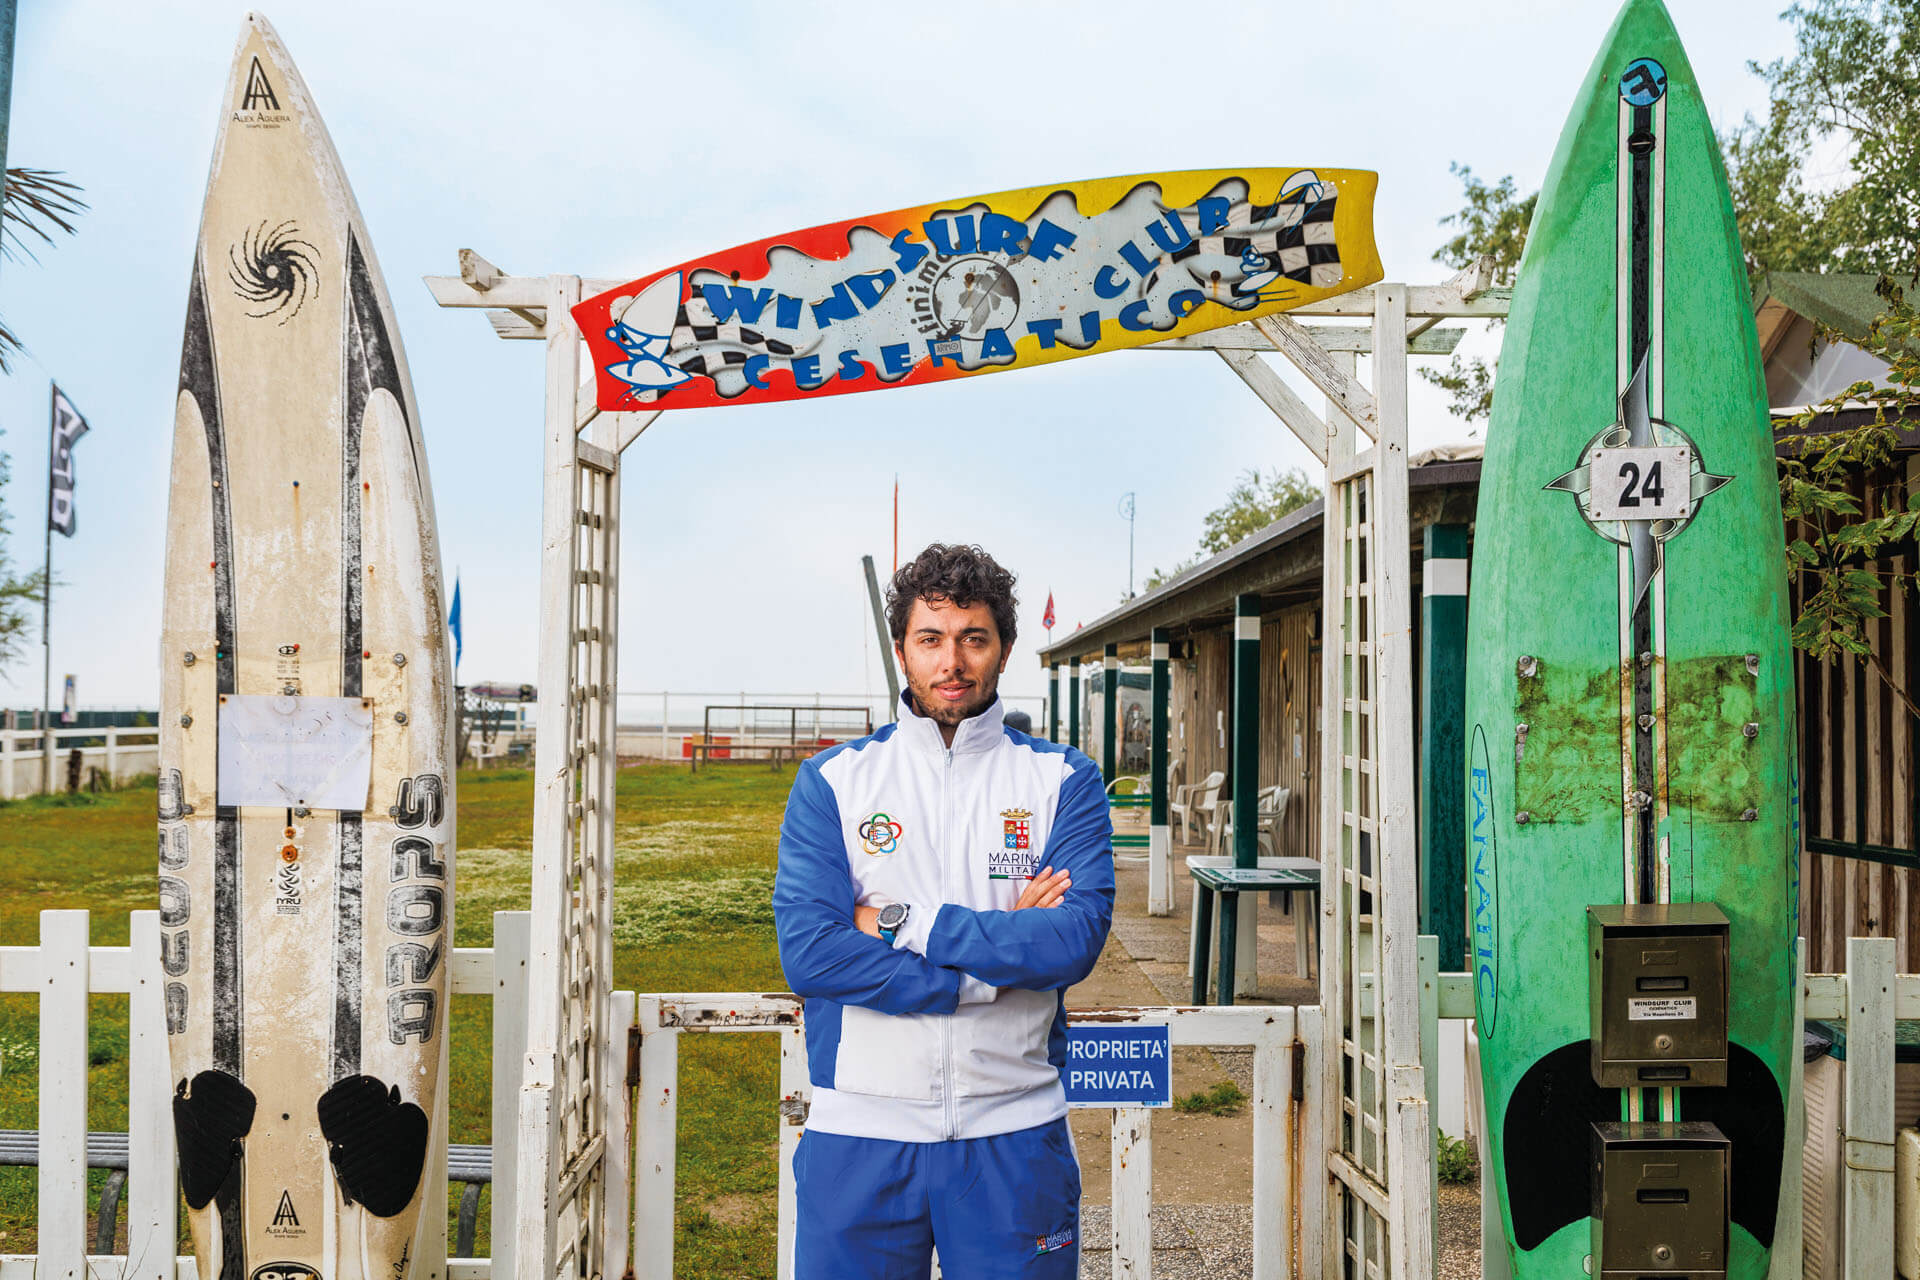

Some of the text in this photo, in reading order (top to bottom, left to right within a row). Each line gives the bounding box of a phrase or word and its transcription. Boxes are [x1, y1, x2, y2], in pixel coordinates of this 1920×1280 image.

[702, 196, 1231, 329] WINDSURF CLUB
[743, 288, 1206, 389] CESENATICO
[1617, 461, 1665, 508] 24
[988, 852, 1040, 865] MARINA
[1471, 766, 1496, 1000] FANATIC
[1070, 1070, 1155, 1089] PRIVATA
